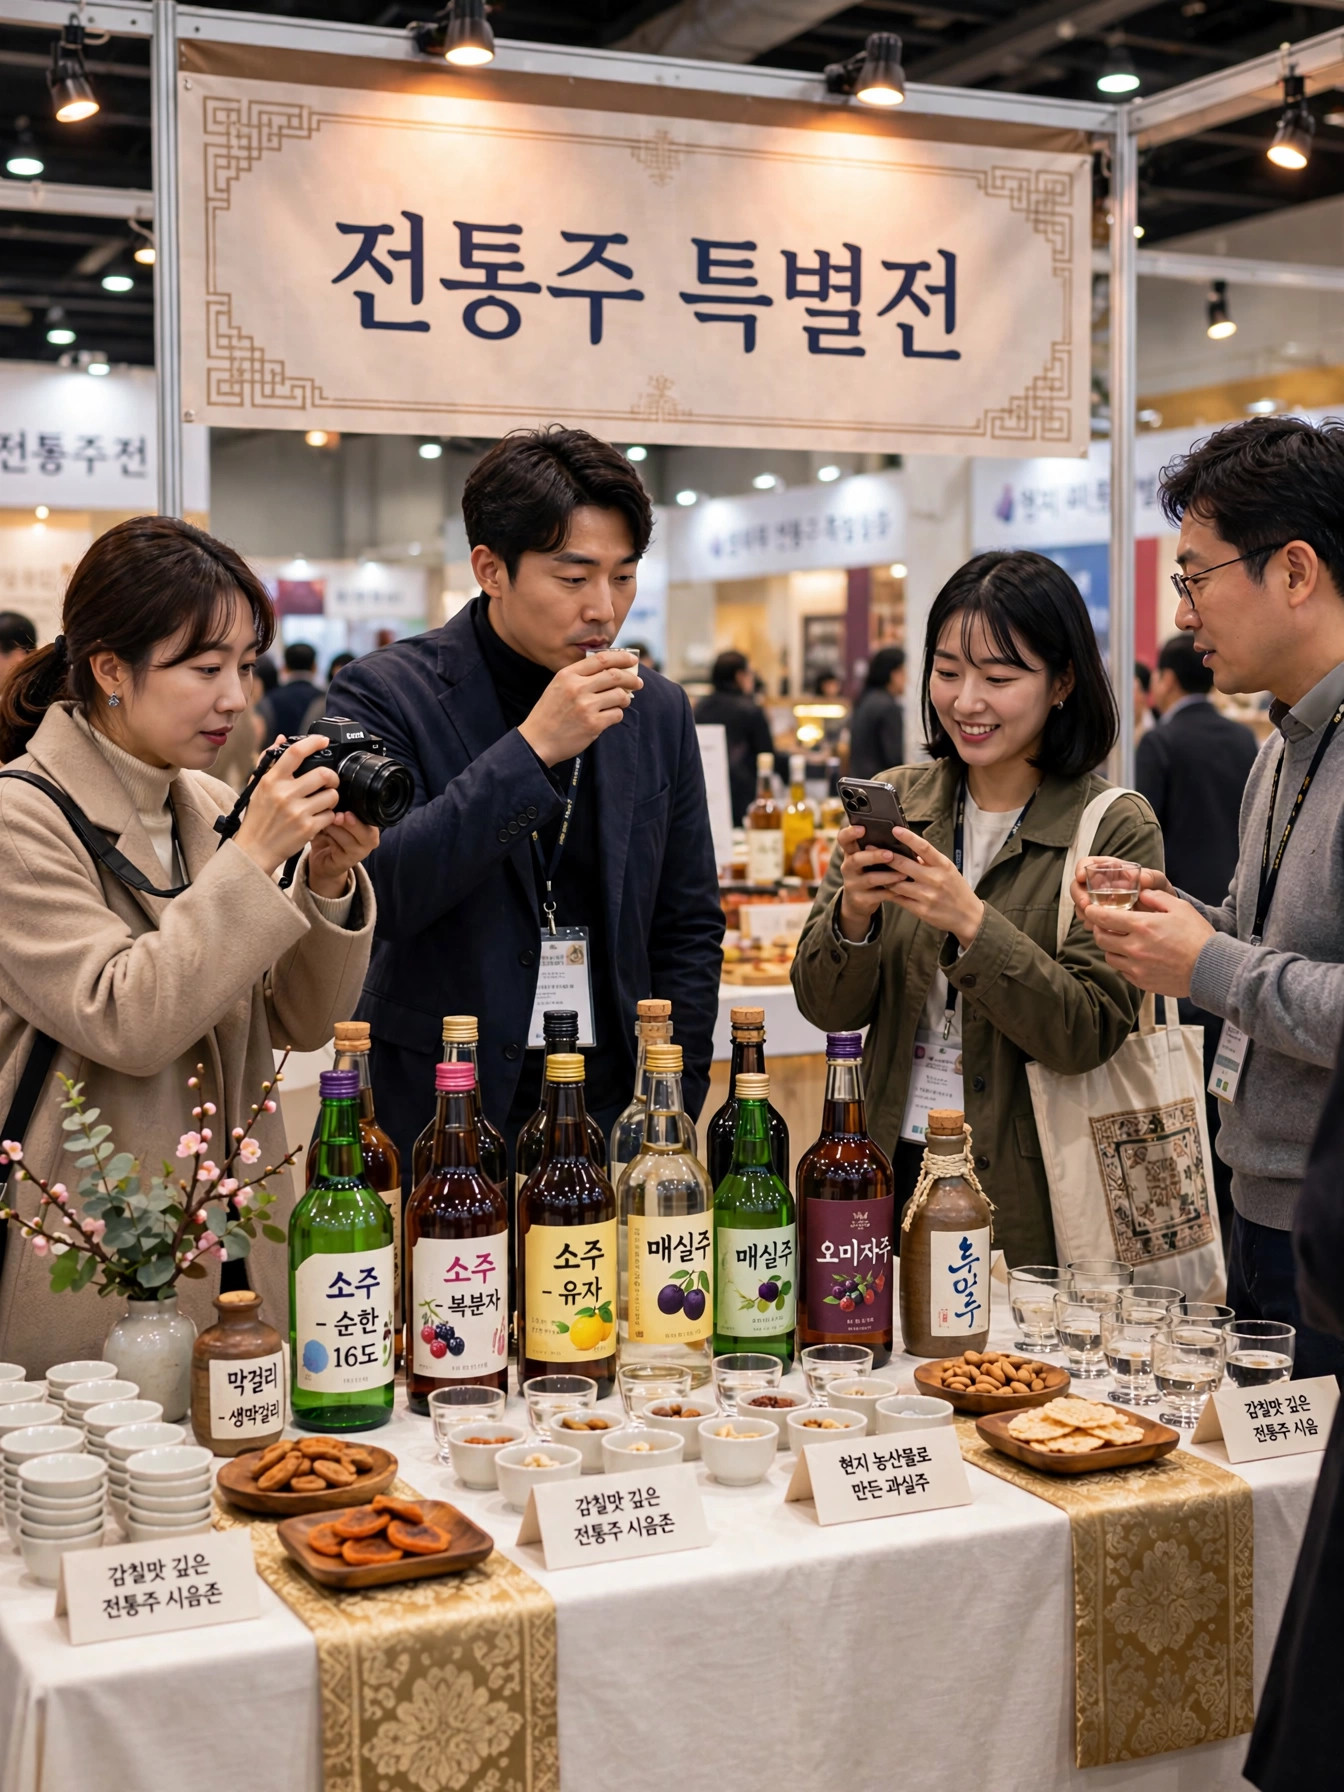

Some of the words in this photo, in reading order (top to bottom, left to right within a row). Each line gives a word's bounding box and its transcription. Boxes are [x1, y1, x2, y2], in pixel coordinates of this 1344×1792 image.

[331, 210, 645, 345] 전통주
[679, 238, 961, 360] 특별전
[553, 1239, 604, 1271] 소주
[647, 1230, 711, 1263] 매실주
[735, 1240, 792, 1271] 매실주
[816, 1236, 891, 1266] 오미자주
[326, 1266, 380, 1300] 소주
[443, 1252, 496, 1284] 소주
[448, 1288, 501, 1318] 복분자
[558, 1276, 602, 1305] 유자
[334, 1306, 379, 1337] 순한
[333, 1342, 379, 1368] 16도
[227, 1362, 277, 1397] 막걸리
[1244, 1397, 1284, 1420] 감칠맛
[1285, 1394, 1311, 1414] 깊은
[1253, 1422, 1291, 1443] 전통주
[1294, 1418, 1318, 1437] 시음
[839, 1453, 869, 1475] 현지
[872, 1446, 932, 1471] 농산물로
[575, 1491, 625, 1517] 감칠맛
[628, 1486, 660, 1509] 깊은
[852, 1480, 883, 1501] 만든
[885, 1473, 930, 1496] 과실주
[574, 1521, 623, 1546] 전통주
[627, 1513, 675, 1537] 시음존
[108, 1559, 166, 1587] 감칠맛
[172, 1553, 210, 1578] 깊은
[103, 1591, 161, 1619] 전통주
[166, 1582, 223, 1609] 시음존
